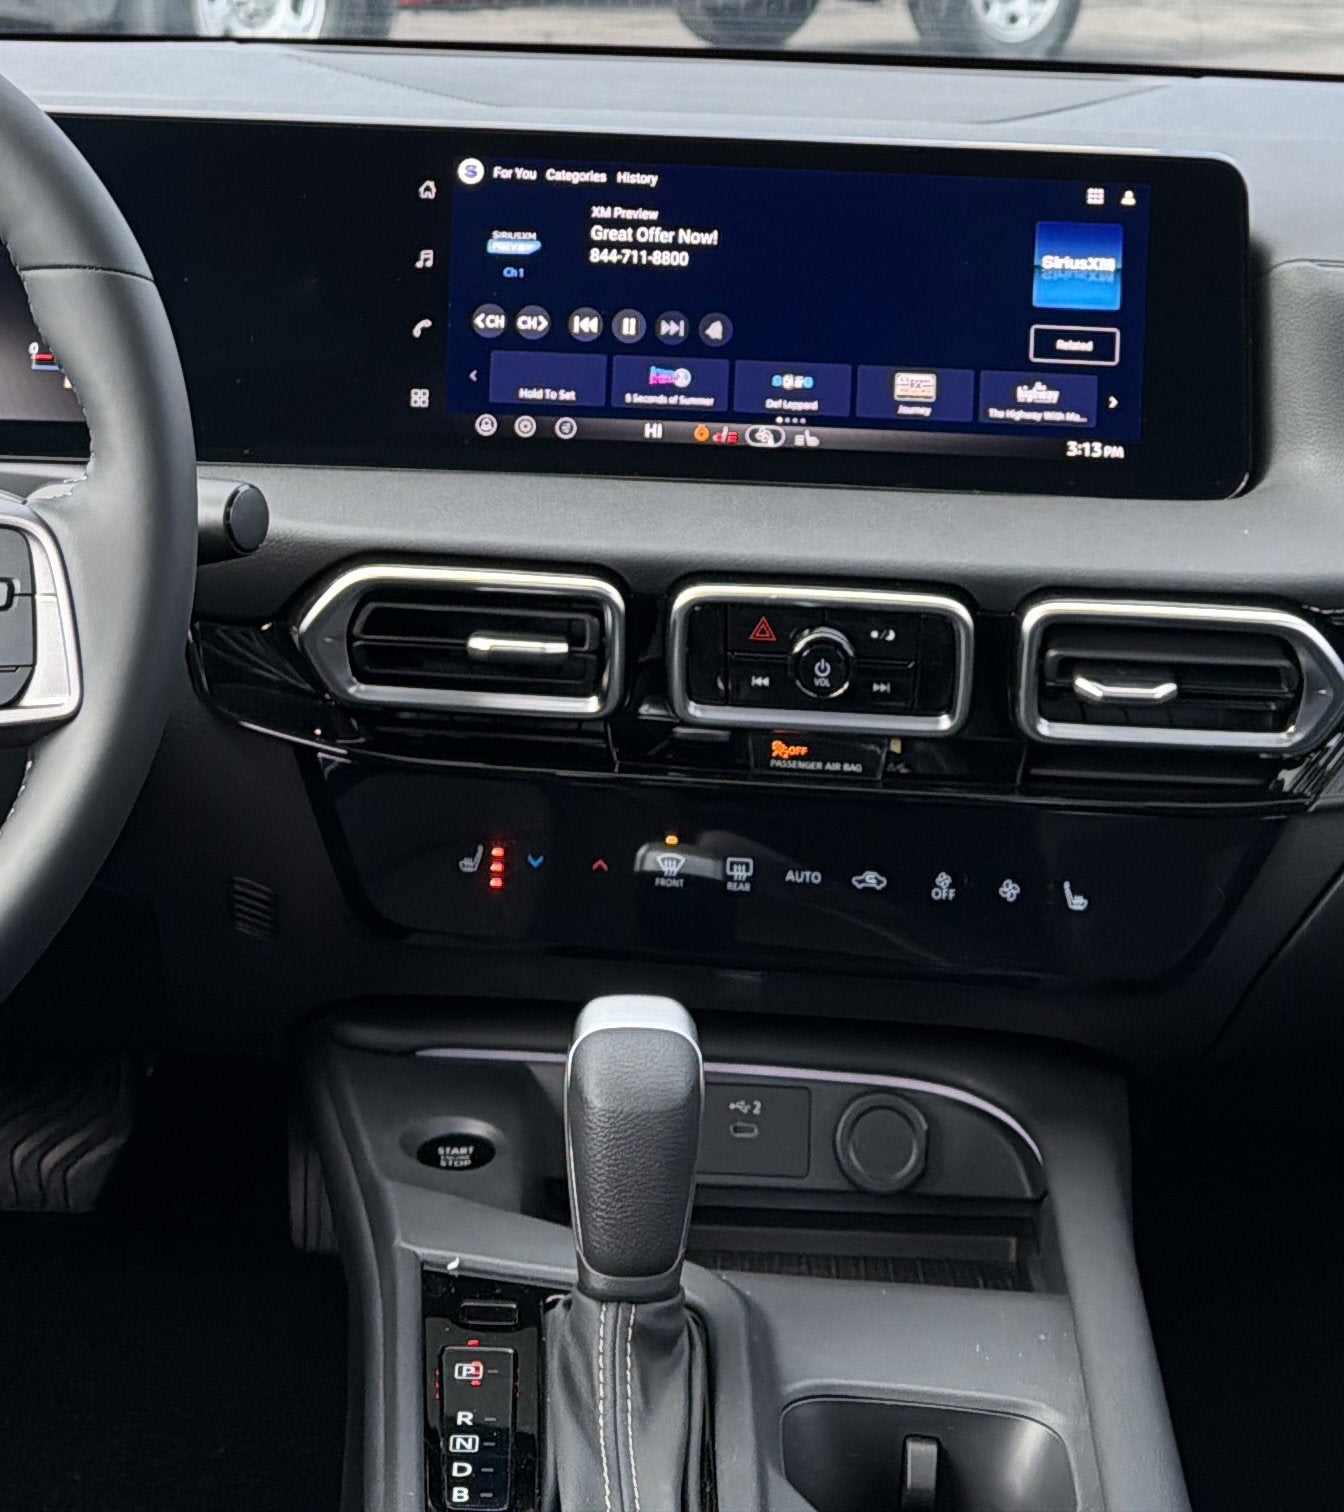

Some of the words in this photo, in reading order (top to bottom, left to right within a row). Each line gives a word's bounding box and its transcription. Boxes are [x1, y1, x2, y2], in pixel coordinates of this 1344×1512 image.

[492, 166, 512, 180] For
[514, 167, 537, 181] You
[545, 168, 607, 185] Categories
[616, 171, 658, 187] History
[590, 205, 611, 219] XM
[613, 206, 659, 221] Preview
[590, 224, 633, 242] Great
[636, 226, 675, 244] Offer
[677, 228, 719, 245] Now!
[589, 248, 689, 267] 844-711-8800
[518, 387, 543, 400] Hold
[544, 389, 558, 401] To
[559, 390, 577, 402] Set
[644, 422, 663, 439] HI
[813, 677, 831, 688] VOL
[789, 746, 809, 756] OFF
[769, 759, 824, 771] PASSENGER
[824, 762, 842, 772] AIR
[843, 763, 863, 774] BAG
[784, 870, 822, 885] AUTO
[726, 881, 752, 893] REAR
[931, 888, 956, 901] OFF
[457, 1411, 474, 1426] R
[455, 1437, 473, 1450] N
[452, 1462, 473, 1477] D
[452, 1486, 469, 1502] B
